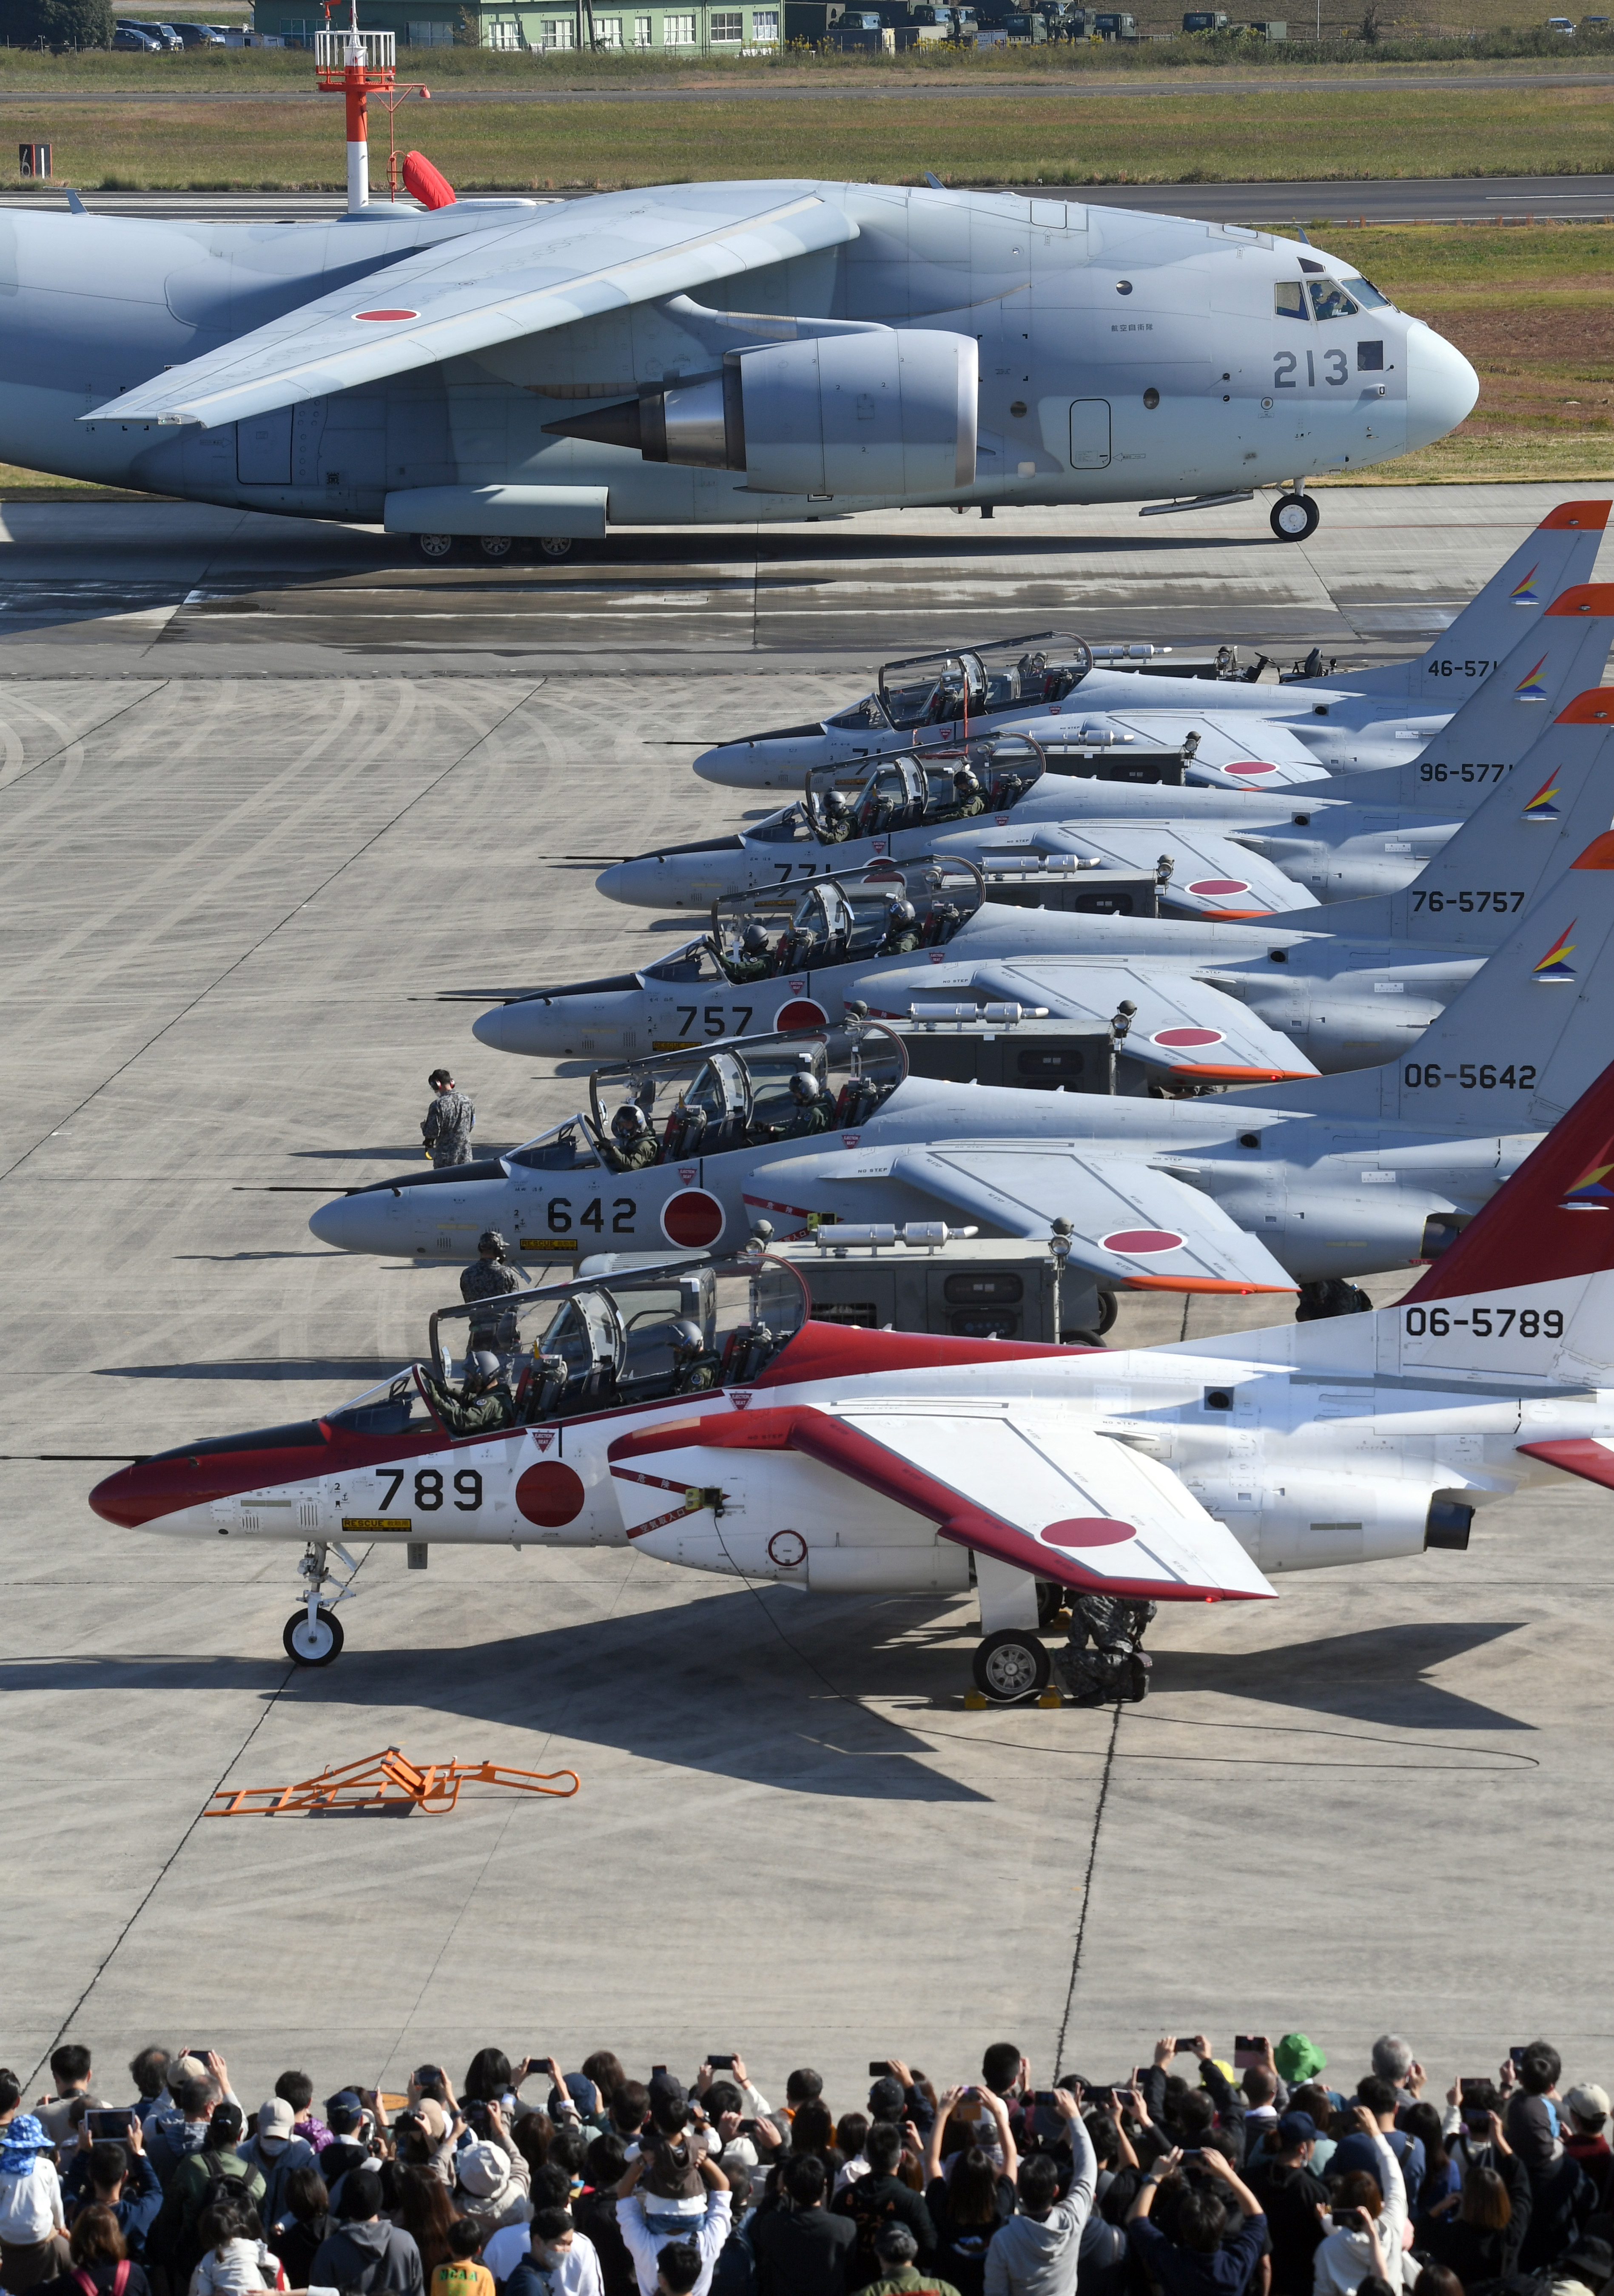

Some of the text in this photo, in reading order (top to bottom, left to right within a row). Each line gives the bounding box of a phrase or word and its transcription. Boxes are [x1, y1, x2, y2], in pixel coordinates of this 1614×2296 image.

[1111, 324, 1153, 332] 航空自衛隊
[1273, 349, 1348, 388] 213
[1412, 891, 1525, 912] 76-5757
[677, 1006, 753, 1036] 757
[1405, 1063, 1536, 1089] 06-5642
[548, 1197, 636, 1233] 642
[1406, 1307, 1563, 1338] 06-5789
[376, 1469, 483, 1511] 789
[637, 1473, 670, 1489] 危険
[640, 1508, 685, 1534] 空気取入口
[439, 2269, 478, 2282] NCAA
